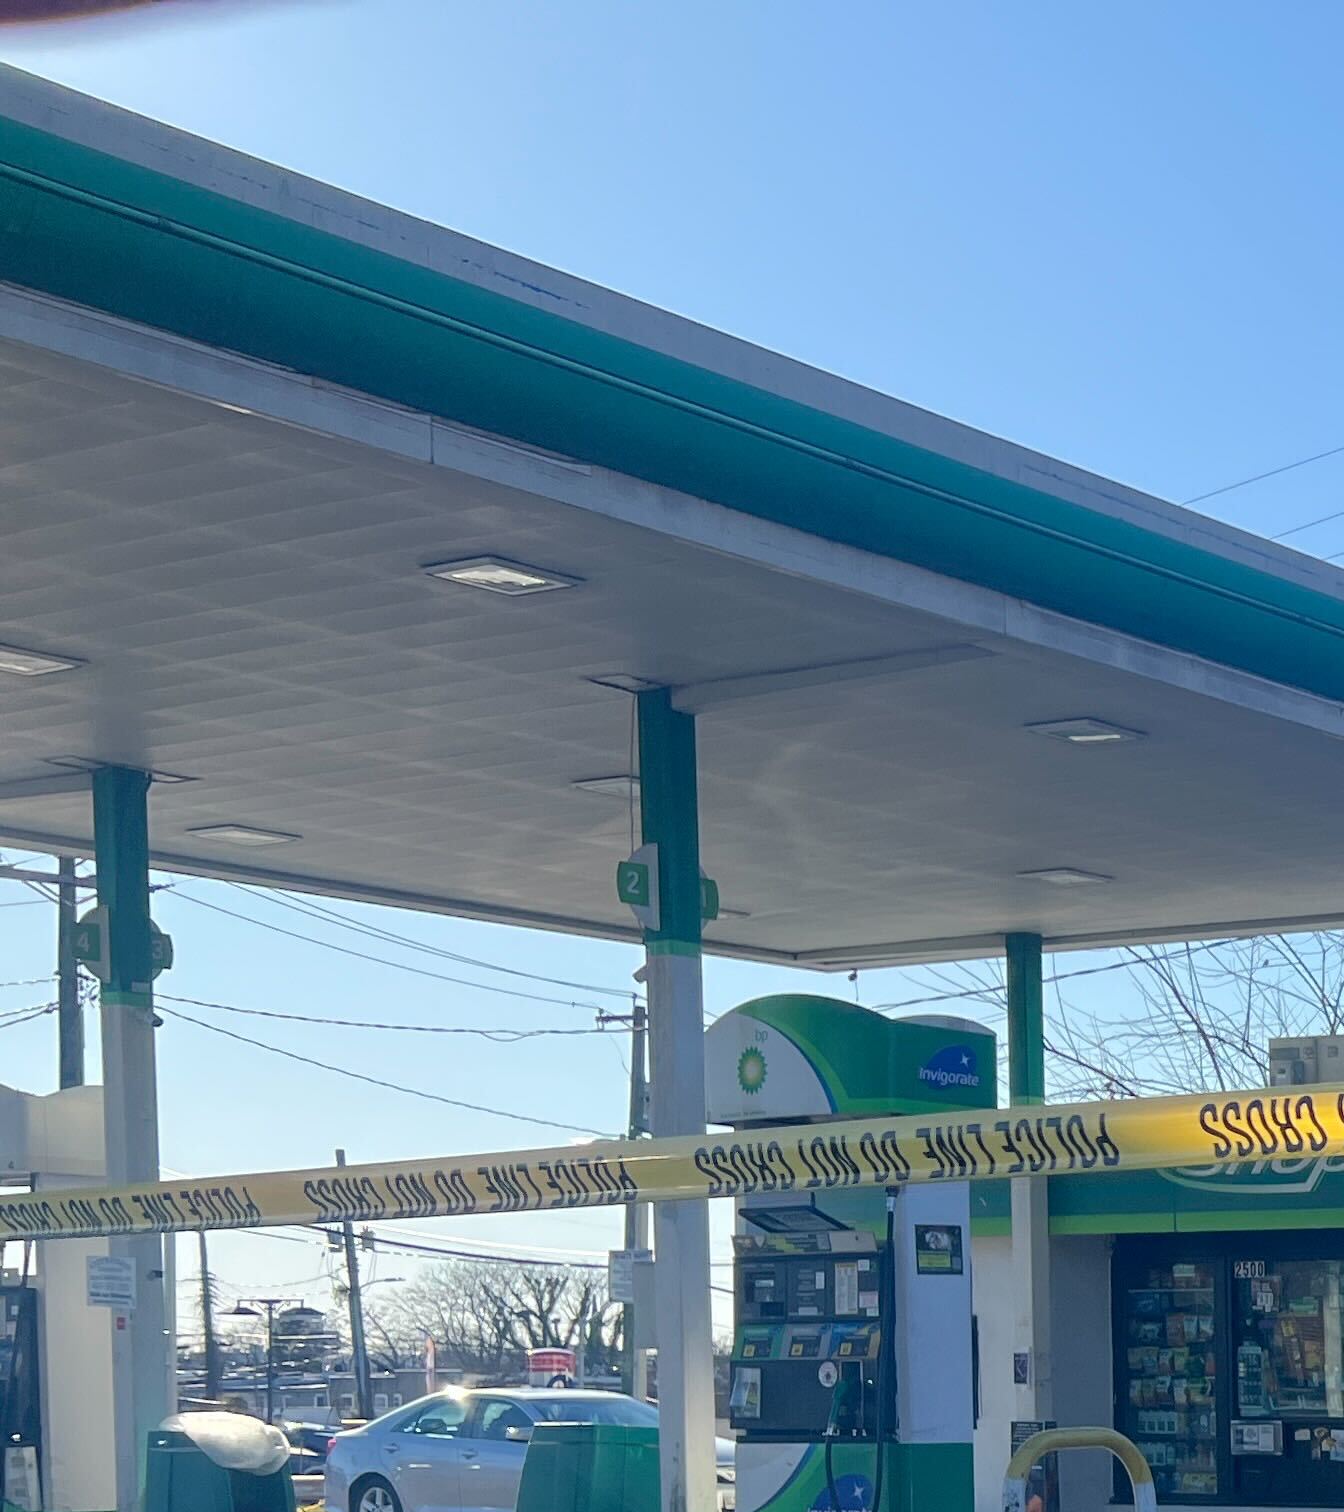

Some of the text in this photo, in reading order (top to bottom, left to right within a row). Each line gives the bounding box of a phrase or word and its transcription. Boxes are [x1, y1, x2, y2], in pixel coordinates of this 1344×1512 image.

[626, 871, 640, 894] 2
[77, 931, 90, 953] 4
[152, 940, 164, 960] 3
[755, 1028, 768, 1043] bp
[1199, 1095, 1328, 1158] CROSS
[694, 1113, 1121, 1196] POLICE LINE DO NOT CROSS
[303, 1154, 639, 1223] POLICE LINE DO NOT CROSS
[1235, 1262, 1264, 1277] 2500
